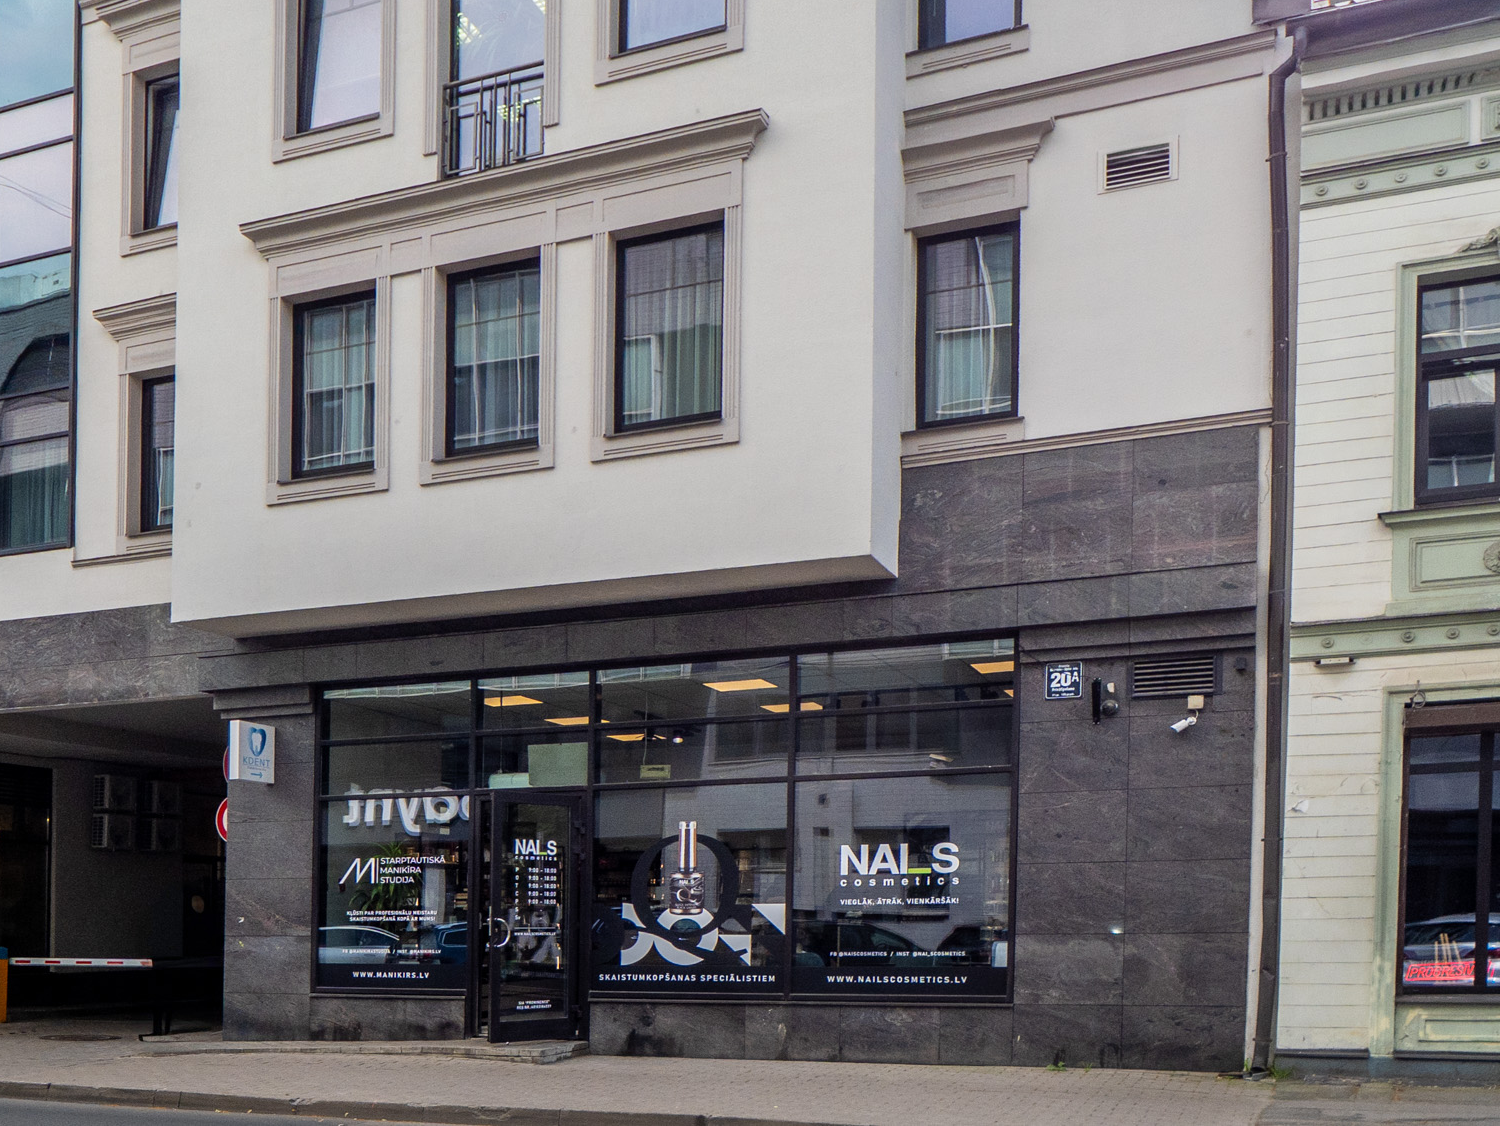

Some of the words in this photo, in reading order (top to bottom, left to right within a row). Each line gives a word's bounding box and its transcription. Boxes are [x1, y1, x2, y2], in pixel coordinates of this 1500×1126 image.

[243, 756, 271, 767] KDENT
[380, 855, 446, 865] STARPTAUTISKĀ
[380, 865, 422, 874] MANIKĪRA
[380, 876, 415, 884] STUDIJA
[840, 876, 960, 887] cosmetics
[840, 897, 875, 906] VIEGLĀK,
[876, 897, 904, 905] ĀTRĀK,
[906, 896, 960, 905] VIENKĀRŠĀK!
[352, 971, 430, 979] WWW.MANIKIRS.LV
[598, 972, 697, 982] SKAISTUMKOPŠANAS
[700, 973, 776, 982] SPECIĀLISTIEM
[827, 975, 968, 984] WWW.NAILSCOSMETICS.LV
